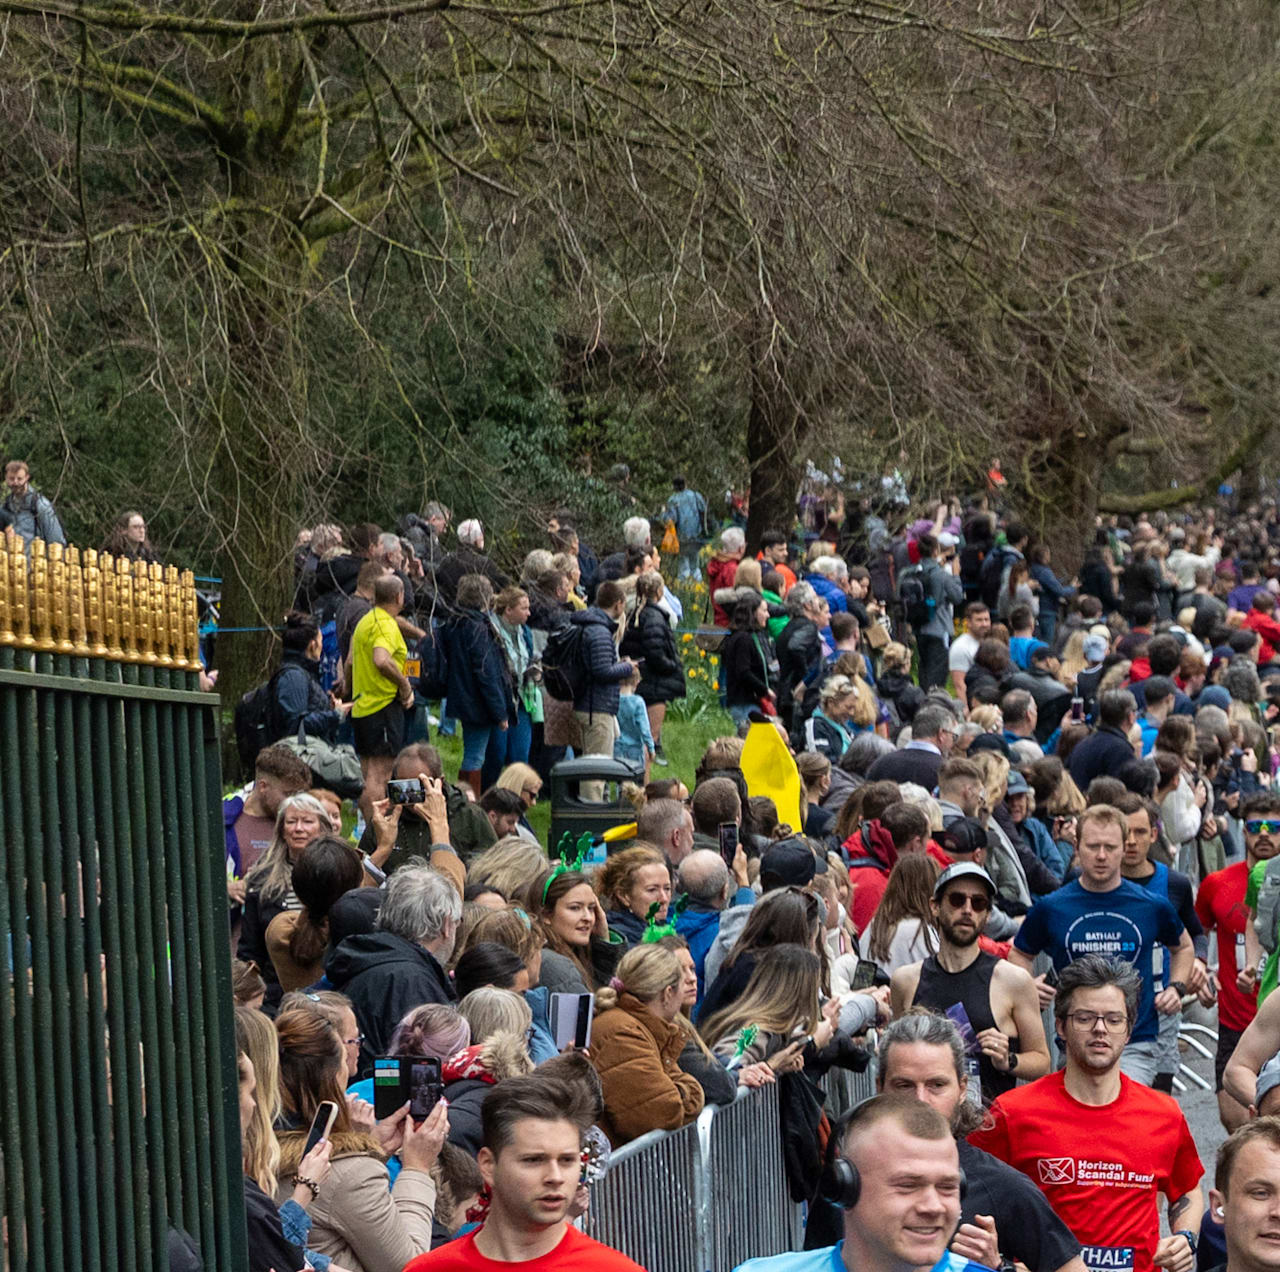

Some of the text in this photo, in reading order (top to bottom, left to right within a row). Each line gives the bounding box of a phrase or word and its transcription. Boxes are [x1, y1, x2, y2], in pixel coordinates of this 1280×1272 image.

[1085, 932, 1121, 940] BATHALF
[1072, 942, 1135, 952] FINISHER 23
[1078, 1160, 1123, 1171] Horizon
[1078, 1169, 1155, 1182] Scandal Fund
[1081, 1247, 1133, 1266] THALF
